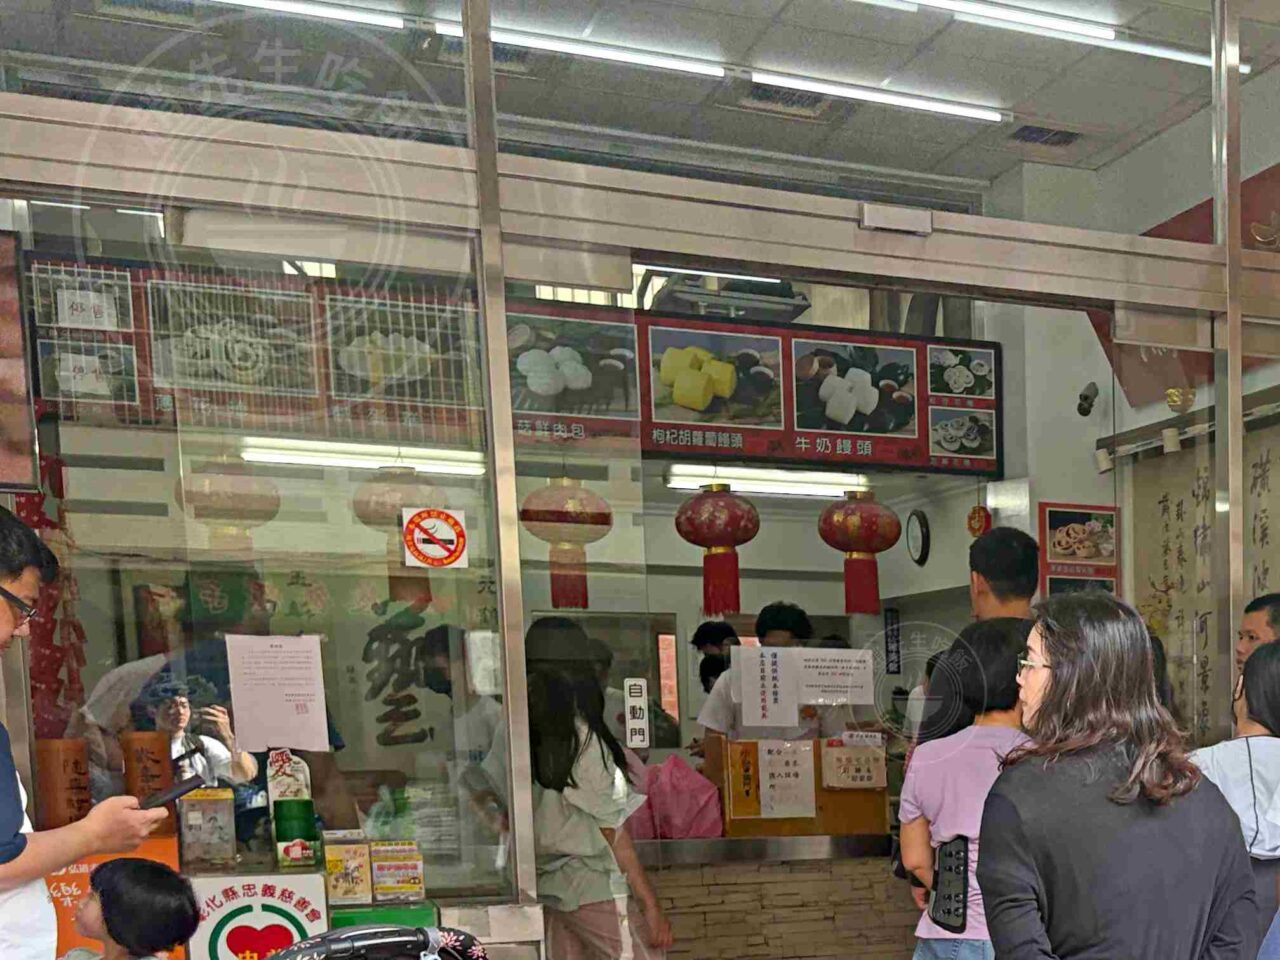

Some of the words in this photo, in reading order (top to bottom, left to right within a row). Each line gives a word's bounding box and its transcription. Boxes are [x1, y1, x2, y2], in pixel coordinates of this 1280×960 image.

[652, 427, 743, 449] 枸杞胡蘿蔔饅頭
[795, 436, 873, 456] 牛奶饅頭
[628, 683, 646, 743] 自動門
